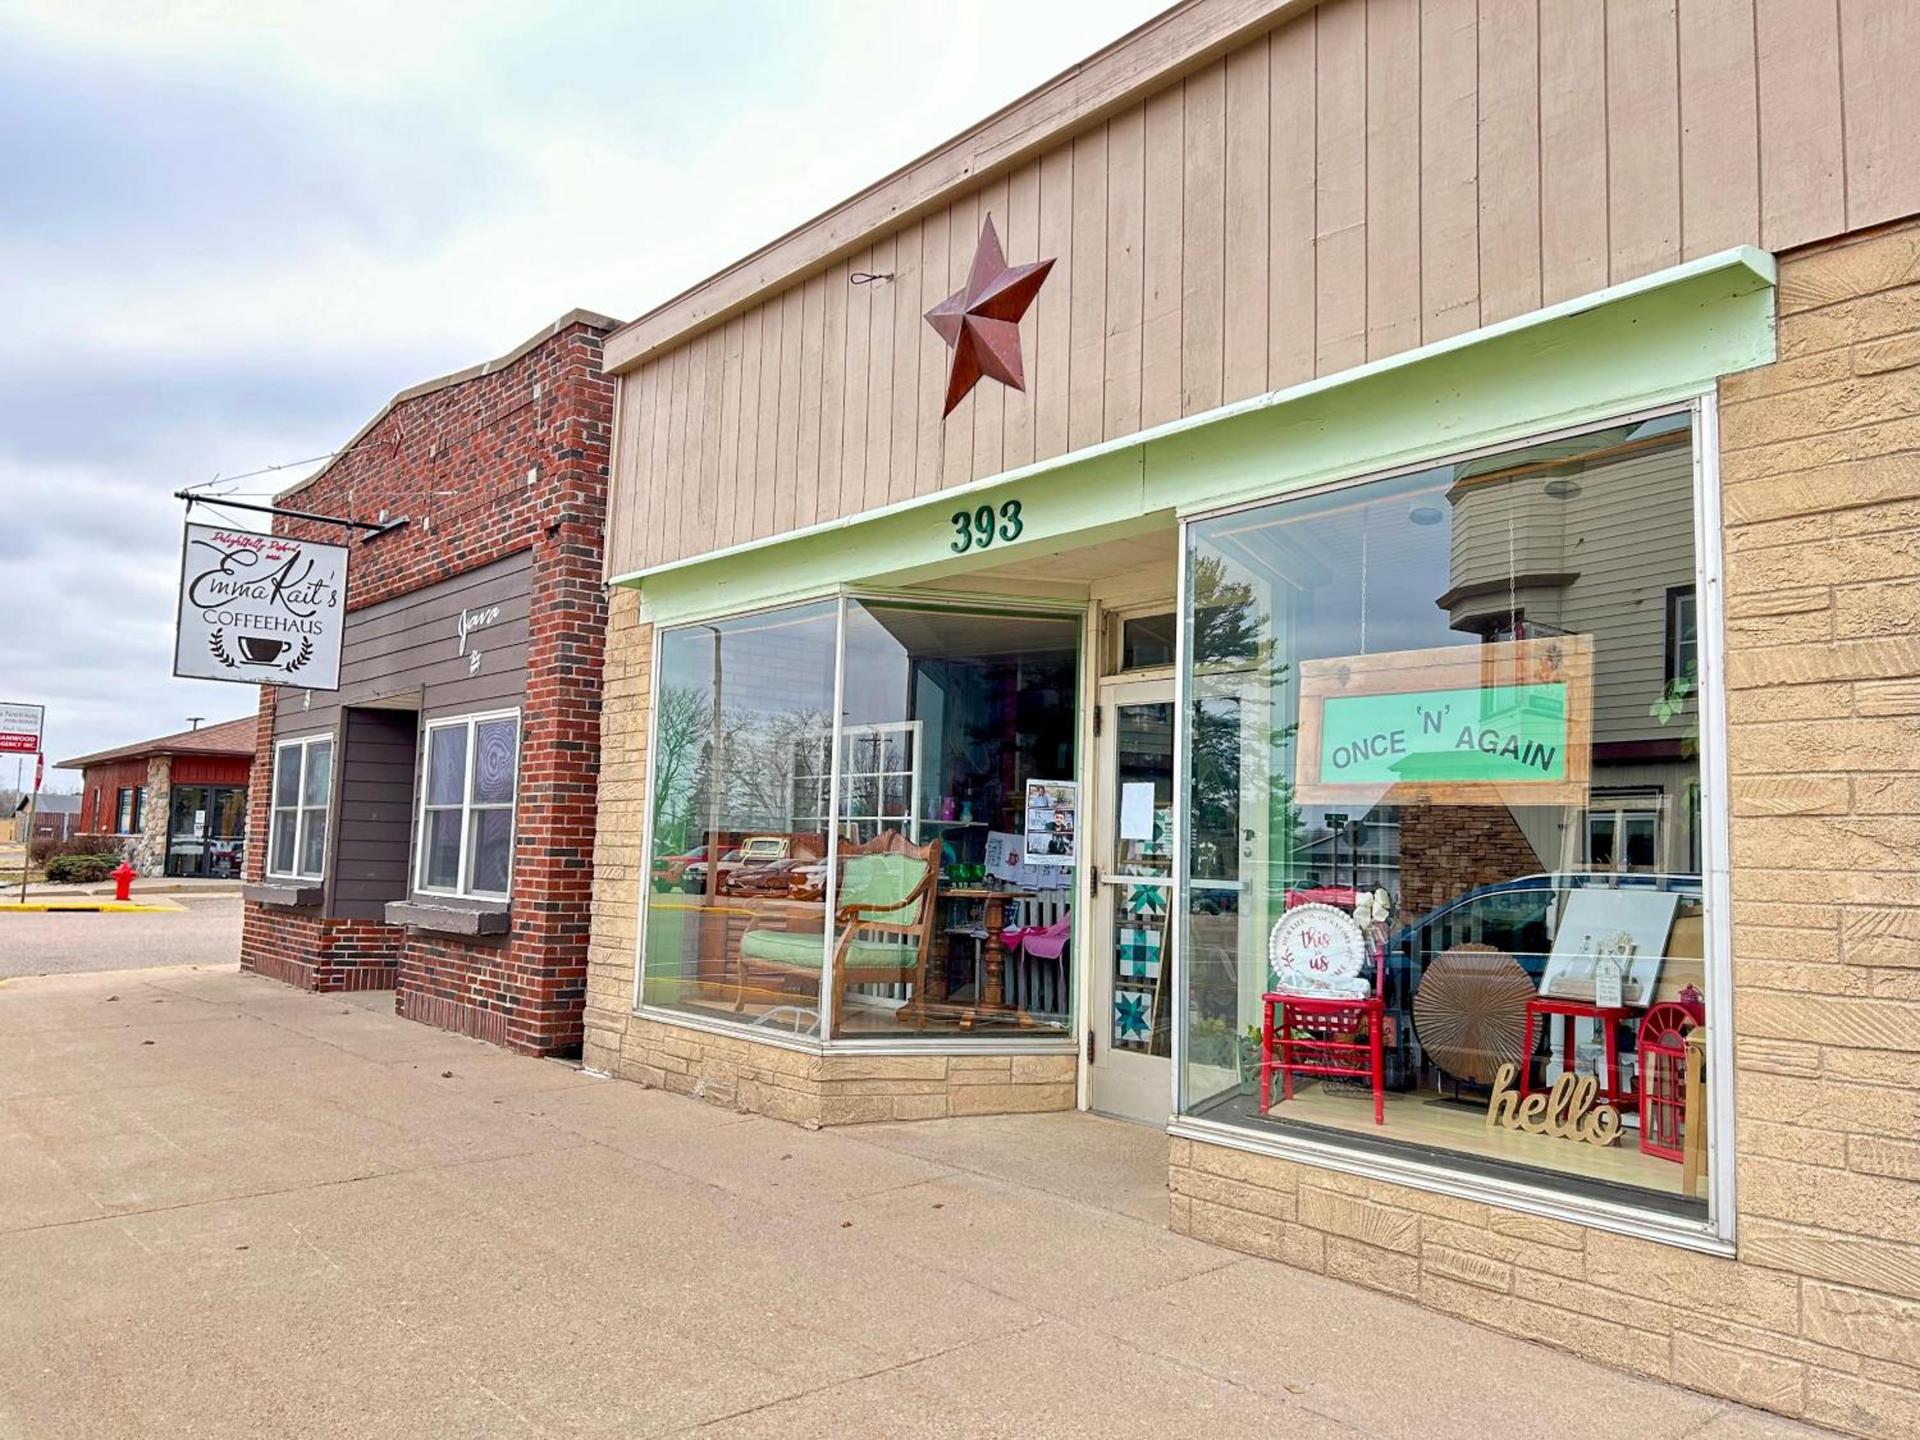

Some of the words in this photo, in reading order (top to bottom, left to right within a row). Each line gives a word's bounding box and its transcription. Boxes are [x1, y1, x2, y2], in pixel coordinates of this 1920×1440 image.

[950, 499, 1024, 553] 393
[202, 609, 324, 636] COFFEEHAUS
[1332, 730, 1406, 769] ONCE
[1455, 725, 1556, 772] AGAIN
[1298, 926, 1332, 949] this
[1309, 954, 1330, 973] us
[1485, 1062, 1627, 1147] hello
